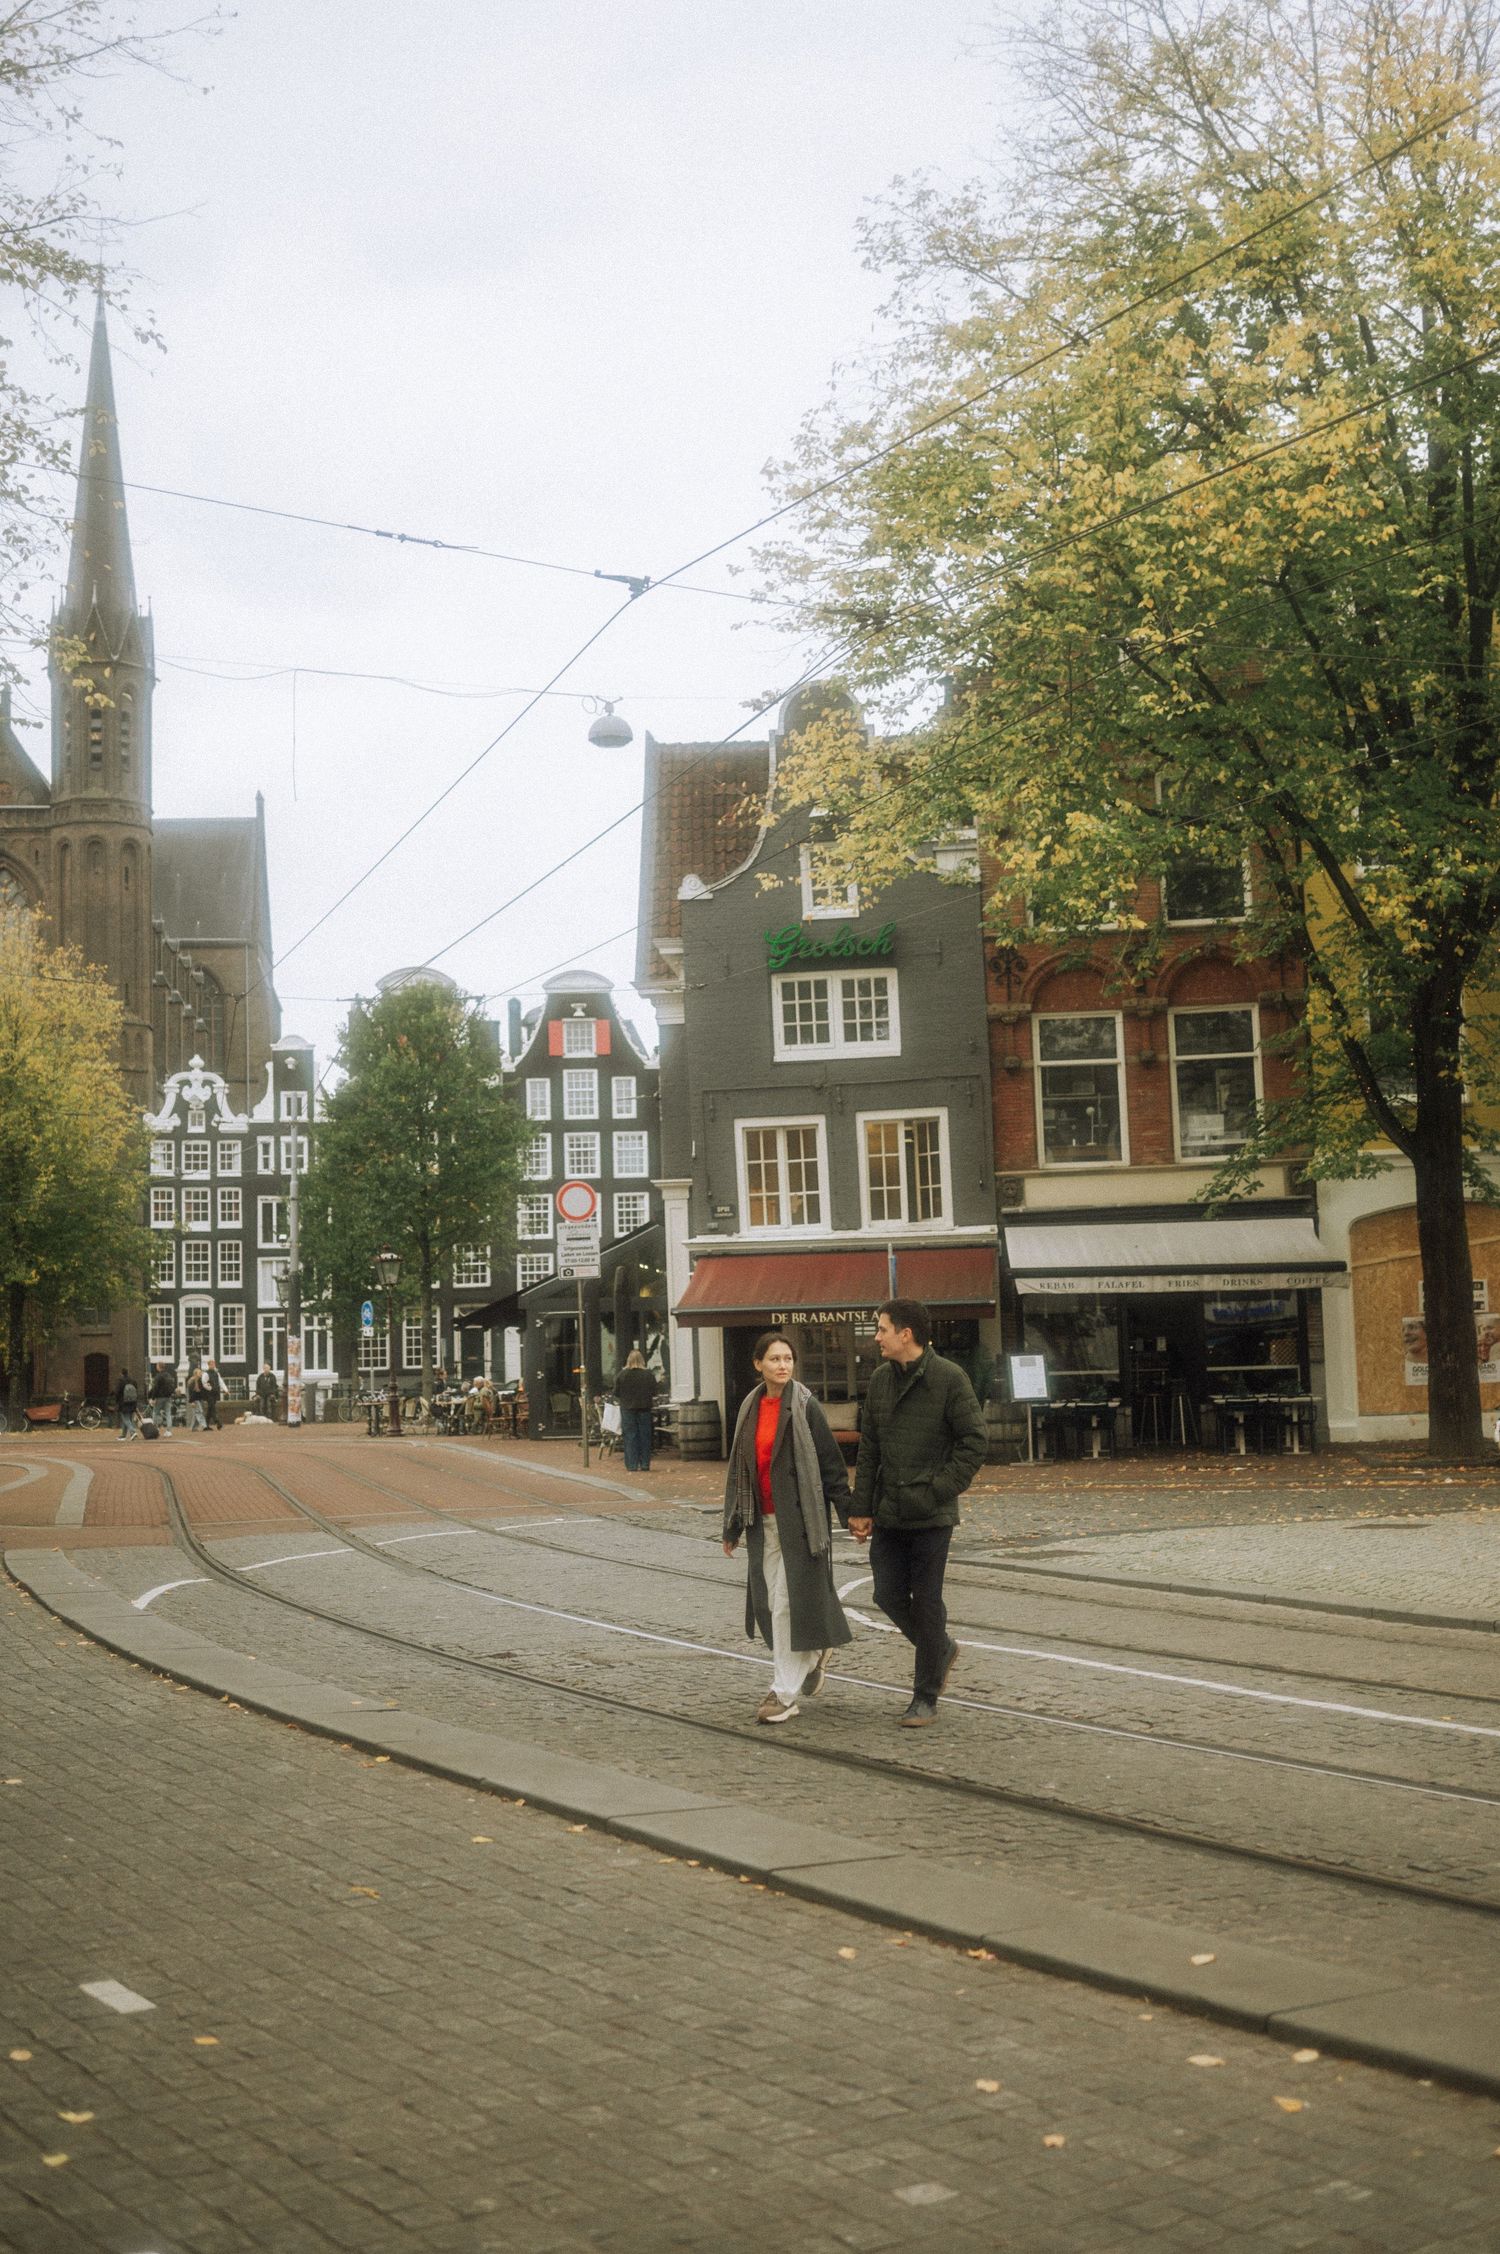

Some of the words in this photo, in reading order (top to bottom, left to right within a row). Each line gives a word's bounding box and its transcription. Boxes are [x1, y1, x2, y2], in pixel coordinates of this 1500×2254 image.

[763, 921, 897, 969] Grolsch
[1039, 1281, 1075, 1290] KEBAB
[1097, 1280, 1145, 1289] FALAFEL
[1167, 1279, 1200, 1288] FRIES
[1222, 1278, 1264, 1287] DRINKS
[771, 1312, 788, 1325] DE
[791, 1310, 868, 1324] BRABANTSE
